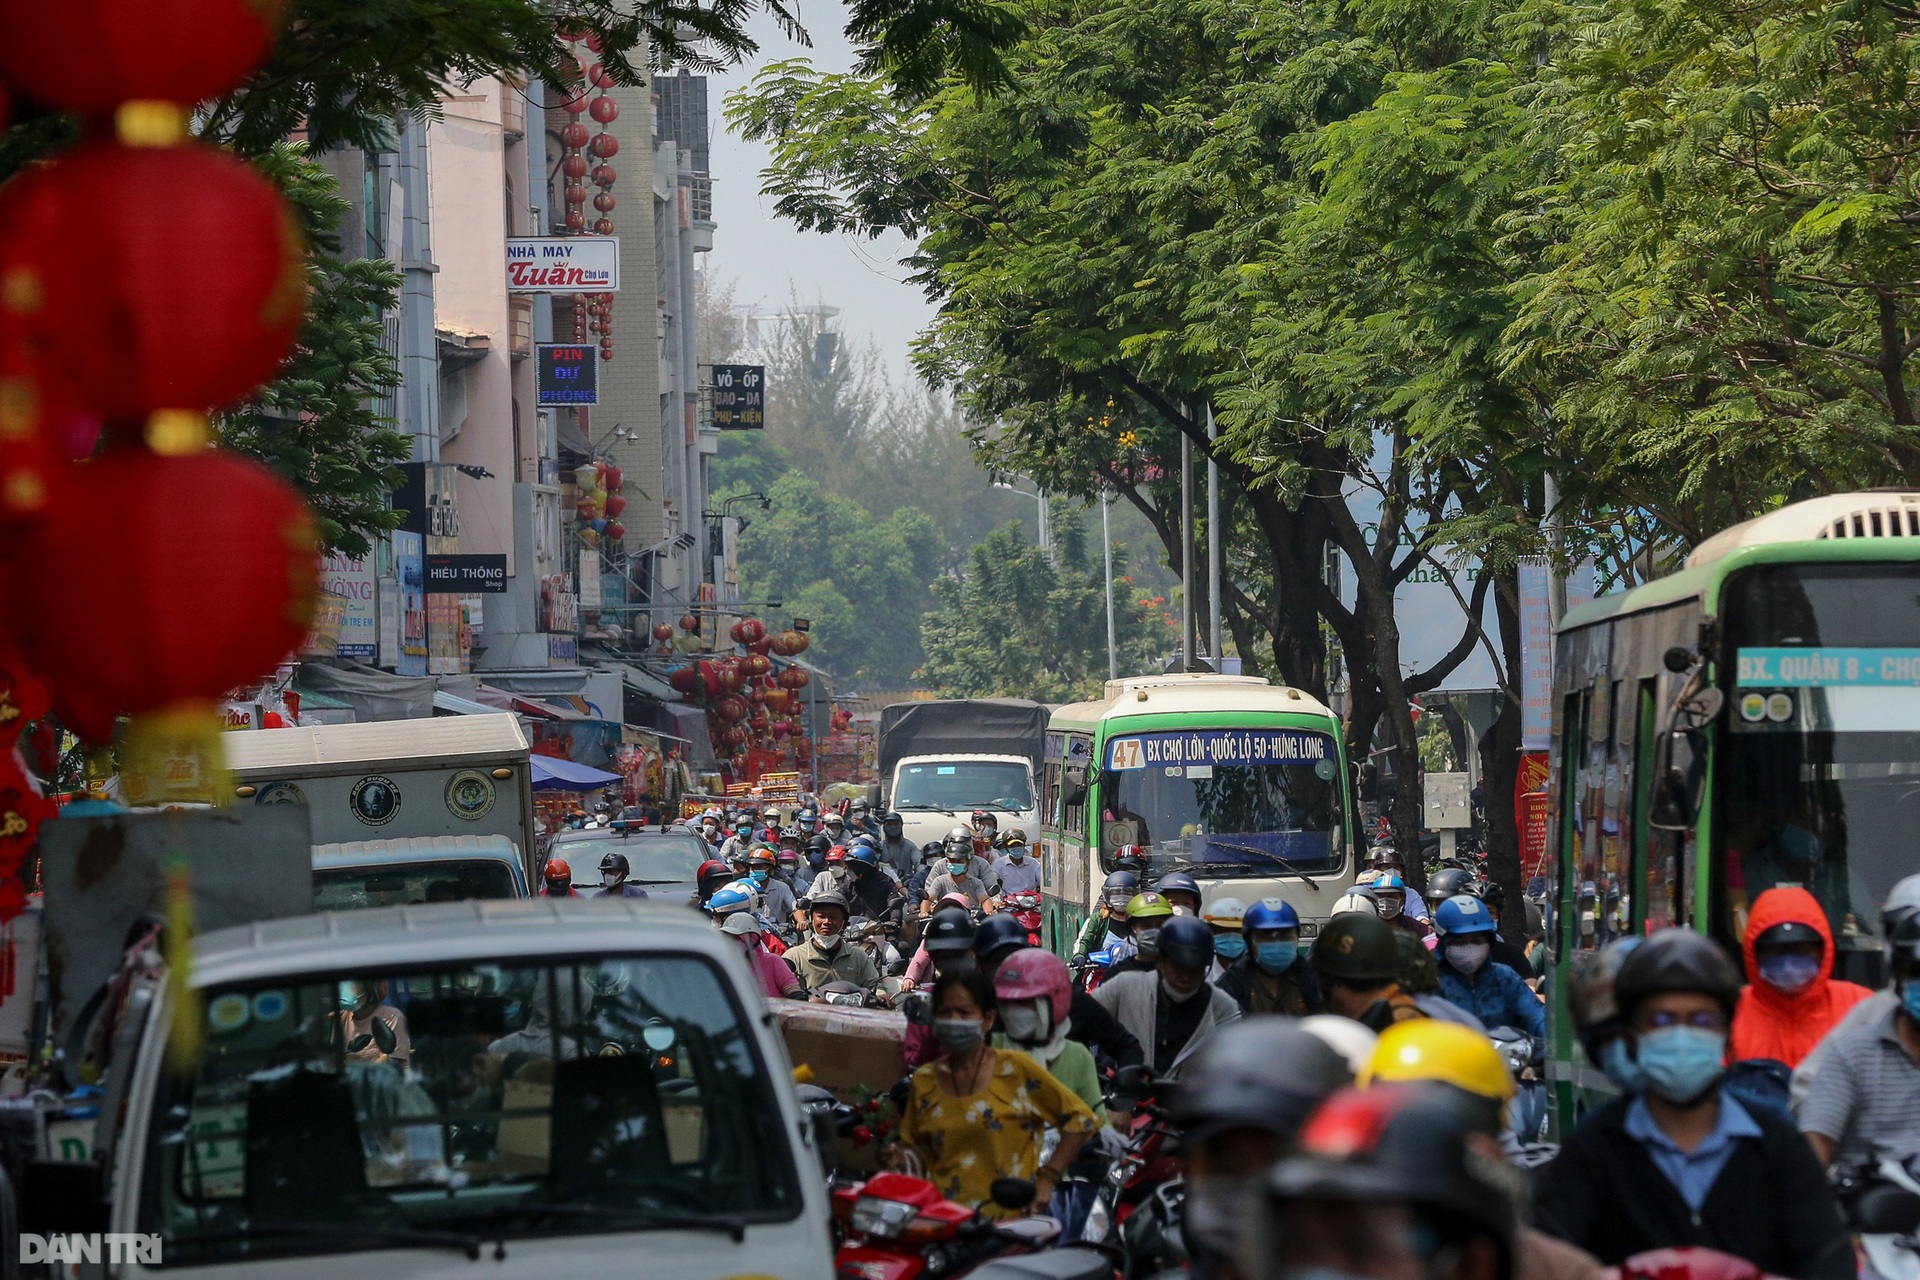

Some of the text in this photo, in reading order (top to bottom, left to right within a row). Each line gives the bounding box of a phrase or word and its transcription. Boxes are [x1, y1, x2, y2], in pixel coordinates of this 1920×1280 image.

[507, 244, 573, 258] NHÀ MAY
[552, 348, 583, 361] PIN
[717, 369, 733, 387] VỎ
[743, 369, 760, 387] ỐP
[715, 391, 736, 405] BAO
[746, 391, 760, 405] DA
[462, 565, 503, 579] THÔNG
[1779, 652, 1840, 685] QUẬN
[1846, 657, 1859, 681] 8
[1114, 741, 1140, 768] 47
[1147, 740, 1160, 762] BX
[1163, 736, 1183, 765] CHỢ
[1186, 734, 1205, 761] LỚN
[1211, 732, 1236, 763] QUỐC
[1239, 732, 1251, 763] LỘ
[1254, 737, 1267, 760] 50
[1299, 737, 1324, 760] LONG
